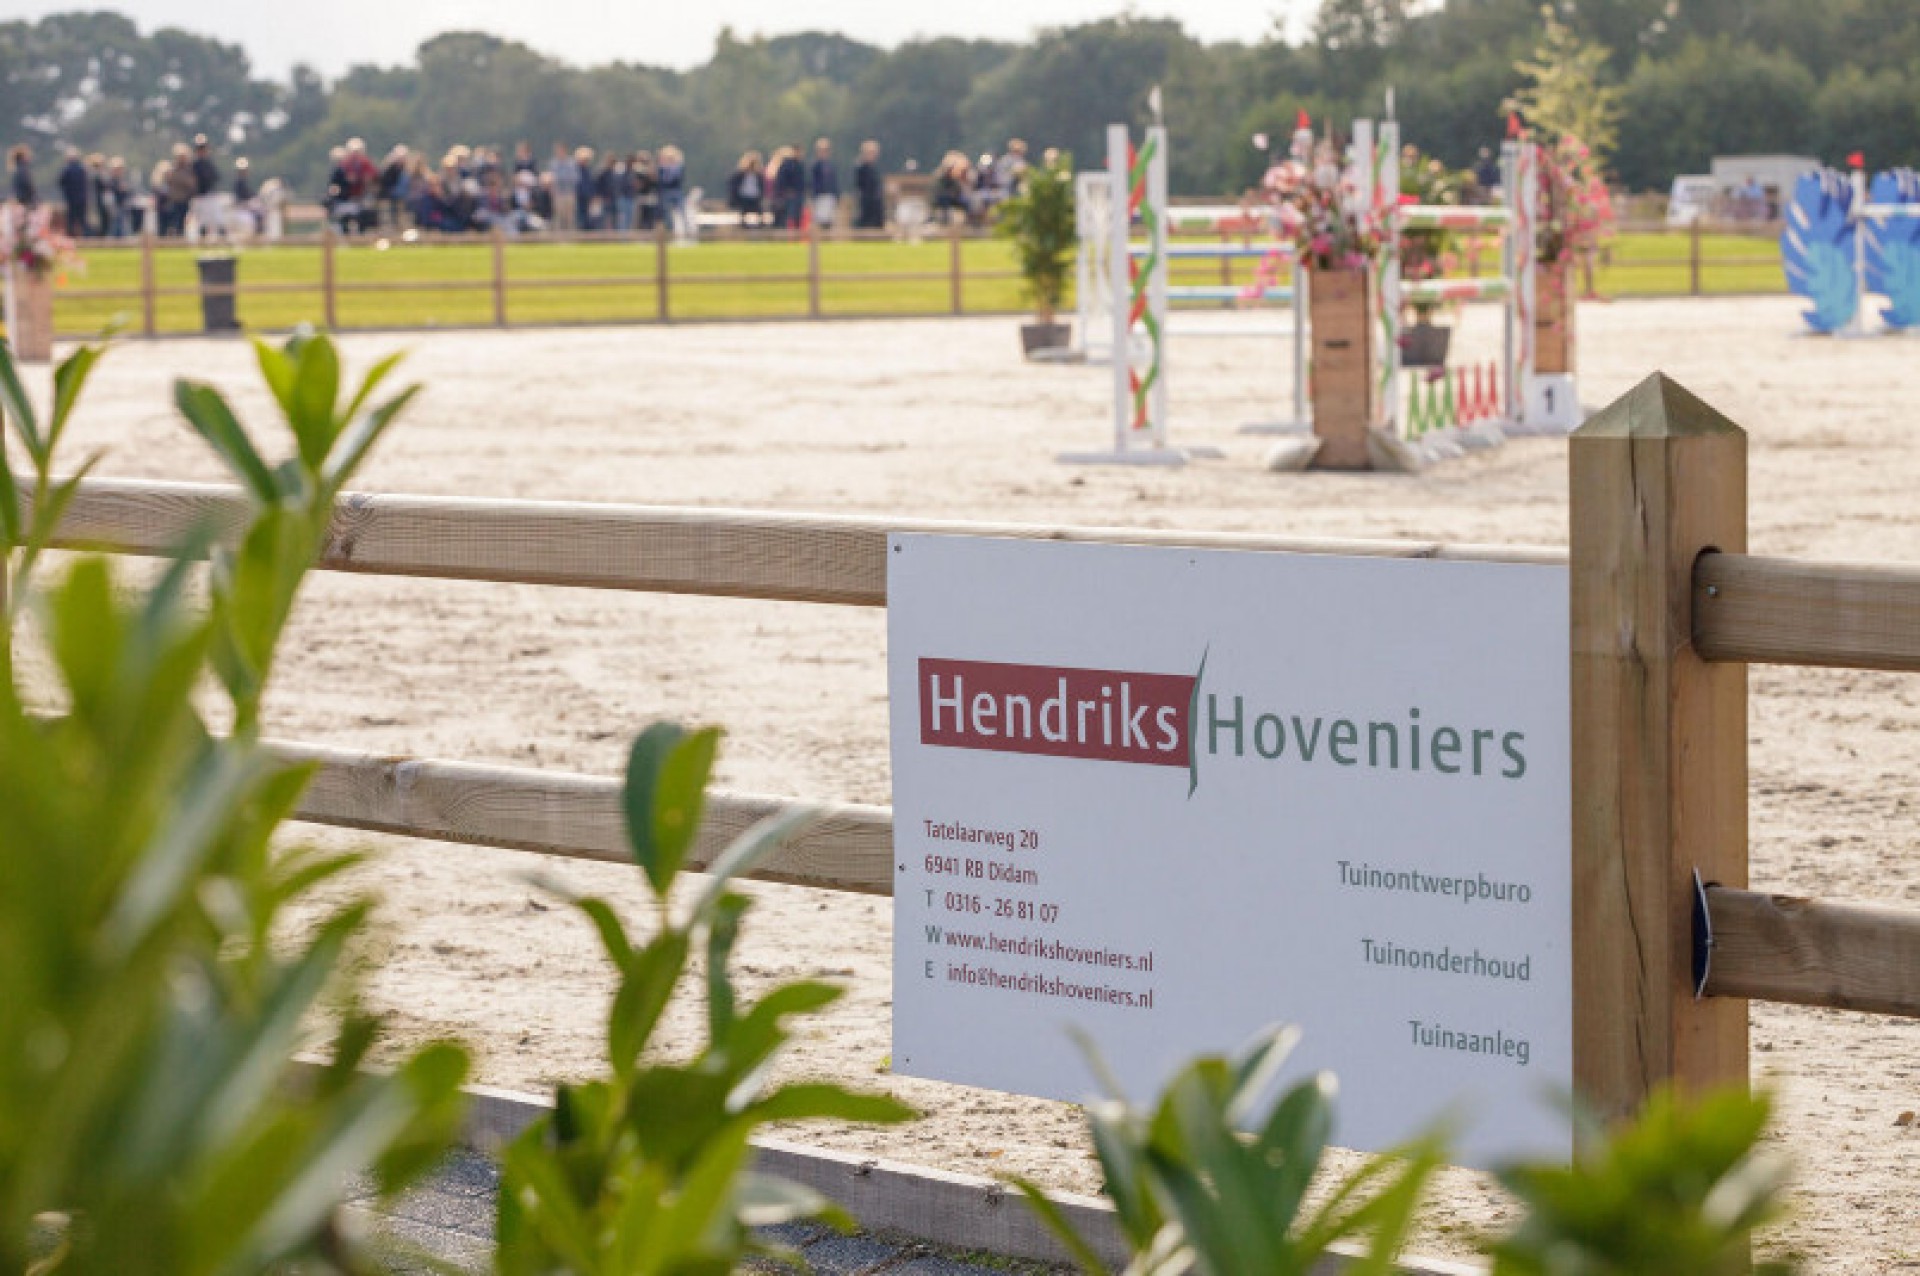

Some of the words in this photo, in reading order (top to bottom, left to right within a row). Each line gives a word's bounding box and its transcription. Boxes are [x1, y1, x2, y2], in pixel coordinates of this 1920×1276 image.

[929, 673, 1179, 752] Hendriks
[1207, 693, 1526, 779] Hoveniers
[923, 820, 1015, 852] Tatelaarweg
[1019, 829, 1039, 850] 20
[924, 854, 960, 875] 6941
[965, 858, 984, 879] RB
[988, 861, 1039, 885] Didam
[1337, 860, 1532, 904] Tuinontwerpburo
[925, 889, 934, 908] T
[944, 891, 982, 914] 0316
[994, 898, 1015, 918] 26
[1018, 901, 1034, 921] 81
[1039, 904, 1060, 923] 07
[925, 925, 943, 944] W
[945, 932, 1153, 972] www.hendrikshoveniers.nl
[1361, 939, 1530, 981] Tuinonderhoud
[925, 960, 934, 979] E
[947, 963, 1153, 1009] info@hendrikshoveniers.nl
[1408, 1020, 1530, 1067] Tuinaanleg
